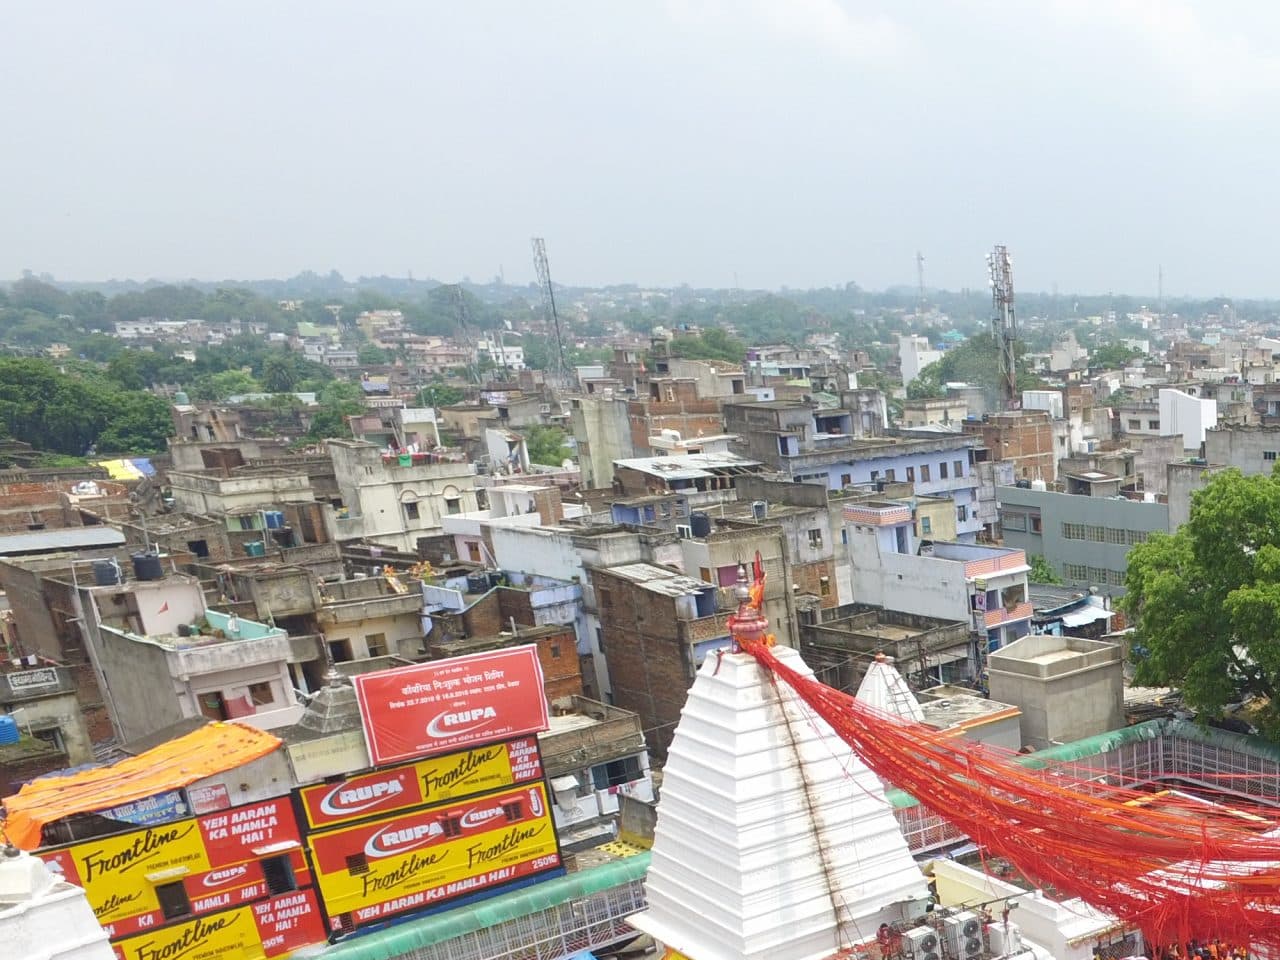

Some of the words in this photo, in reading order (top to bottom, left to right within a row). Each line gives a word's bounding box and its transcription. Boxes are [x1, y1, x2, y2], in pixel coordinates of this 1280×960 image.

[444, 706, 496, 726] RUPA
[511, 741, 527, 750] YEH
[422, 747, 503, 797] Frontline
[340, 780, 403, 804] RUPA
[202, 814, 228, 829] YEH
[232, 804, 276, 823] AARAM
[470, 806, 504, 822] RUPA
[209, 827, 228, 841] KA
[232, 817, 278, 835] MAMLA
[382, 822, 444, 847] RUPA
[81, 824, 194, 882] Frontline
[466, 823, 547, 869] Frontline
[212, 866, 246, 880] RUPA
[361, 850, 449, 898] Frontline
[93, 890, 142, 915] ntline
[138, 915, 154, 927] KA
[195, 893, 230, 911] MAMLA
[255, 903, 271, 915] YEH
[274, 894, 306, 910] AARAM
[357, 906, 381, 921] YEH
[384, 894, 424, 913] AARAM
[427, 888, 445, 903] KA
[447, 876, 486, 895] MAMLA
[261, 913, 275, 925] KA
[277, 904, 311, 920] MAMLA
